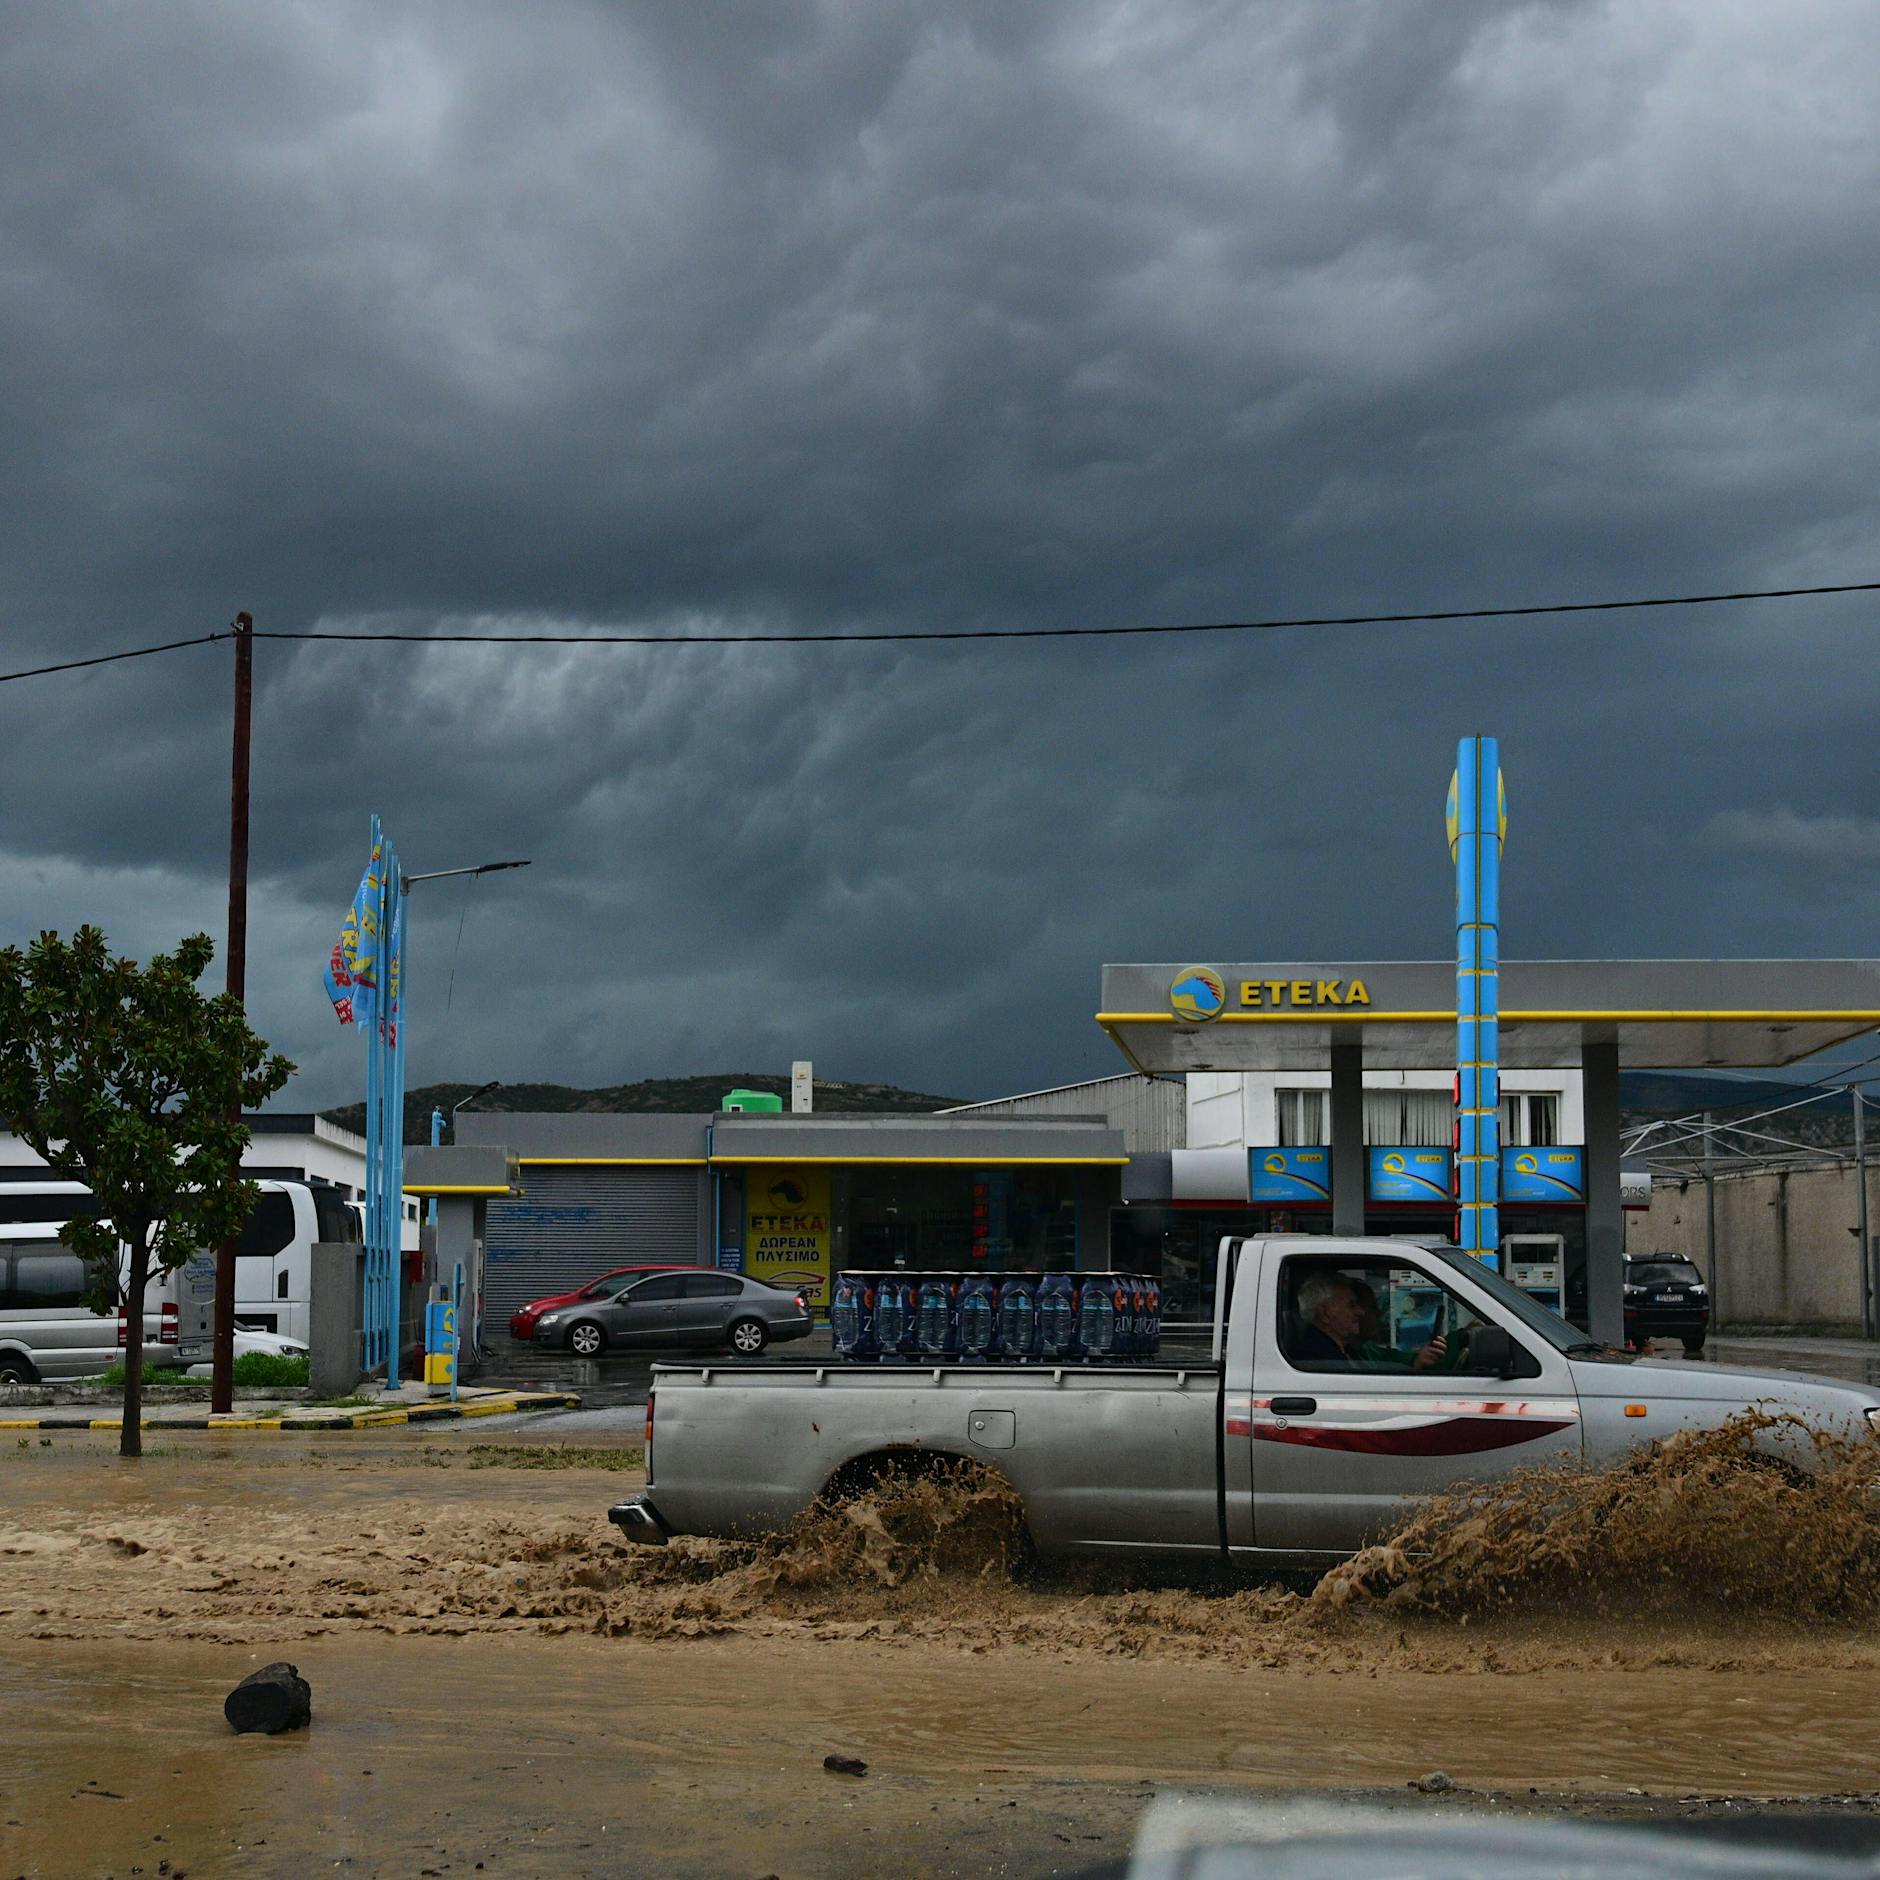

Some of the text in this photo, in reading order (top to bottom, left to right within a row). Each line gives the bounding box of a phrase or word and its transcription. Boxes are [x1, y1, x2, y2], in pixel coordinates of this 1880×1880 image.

[1240, 979, 1370, 1006] ETEKA
[751, 1215, 824, 1232] ETEKA
[759, 1237, 817, 1248] ΔΩΡΕΑΝ
[755, 1250, 820, 1262] ΠΛΥΣΙΜΟ
